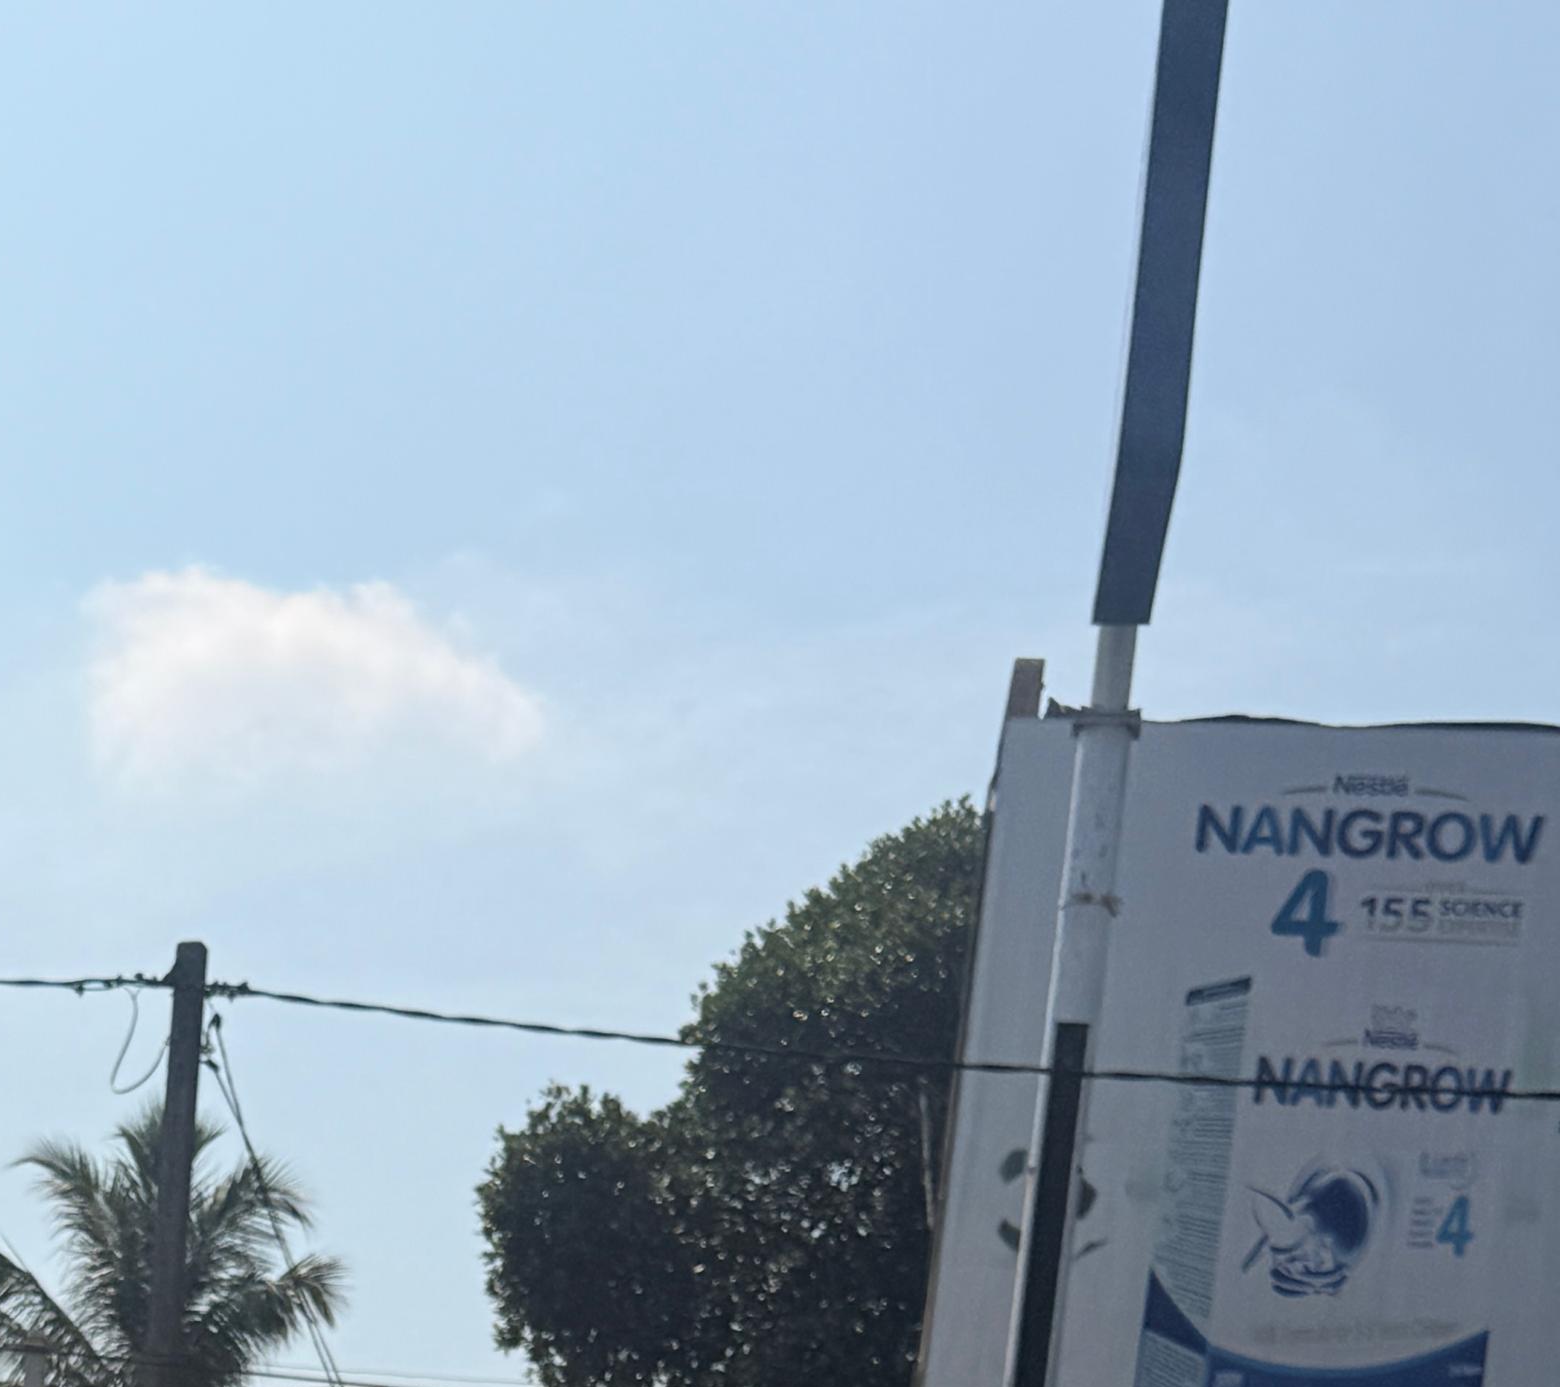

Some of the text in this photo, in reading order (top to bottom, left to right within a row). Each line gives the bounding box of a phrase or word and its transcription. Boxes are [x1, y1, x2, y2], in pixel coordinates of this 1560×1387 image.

[1195, 803, 1545, 864] NANGROW
[1270, 868, 1340, 957] 4
[1359, 896, 1433, 932] 155
[1438, 899, 1525, 918] SCIENCE
[1253, 1056, 1513, 1115] NANGROW
[1434, 1195, 1474, 1258] 4
